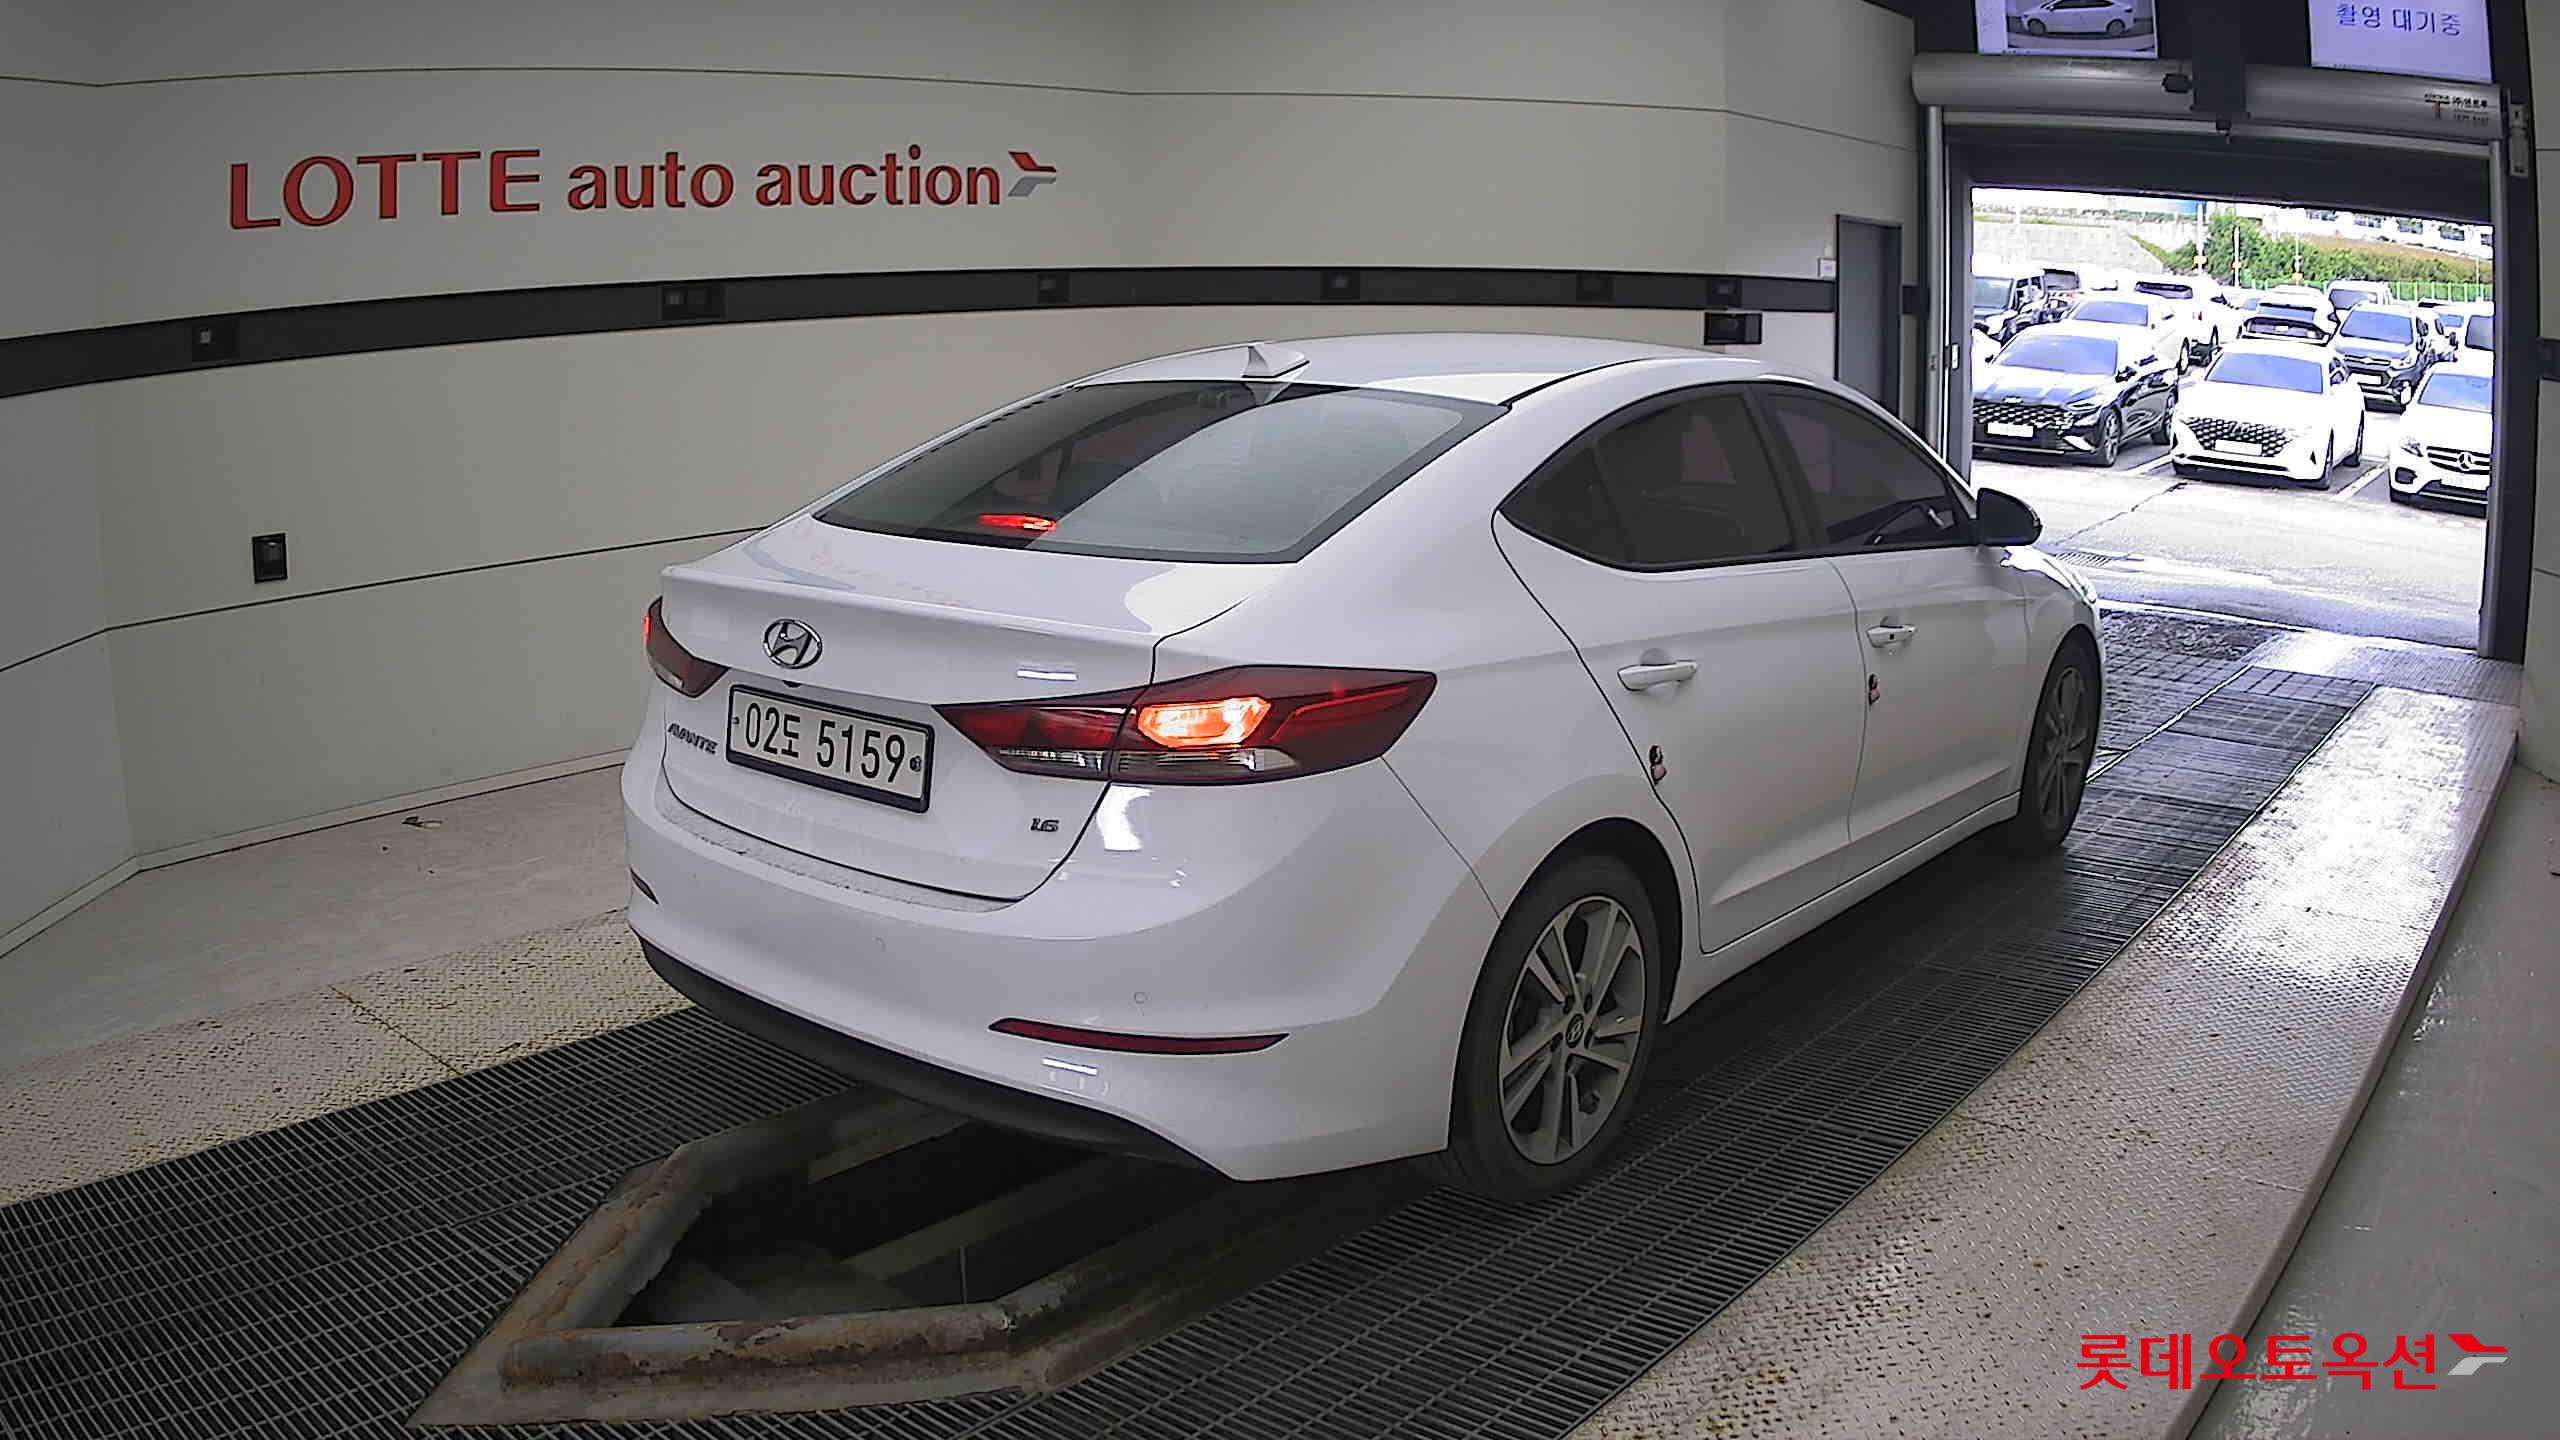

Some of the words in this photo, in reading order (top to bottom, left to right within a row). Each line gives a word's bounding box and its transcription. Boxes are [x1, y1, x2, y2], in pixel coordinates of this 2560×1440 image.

[2337, 3, 2382, 29] 촬영
[2392, 9, 2462, 37] 대기중
[229, 149, 541, 230] LOTTE
[567, 151, 735, 211] auto
[755, 145, 1001, 209] auction
[668, 723, 719, 754] AVANTE
[745, 702, 801, 758] 02도
[815, 720, 906, 783] 5159
